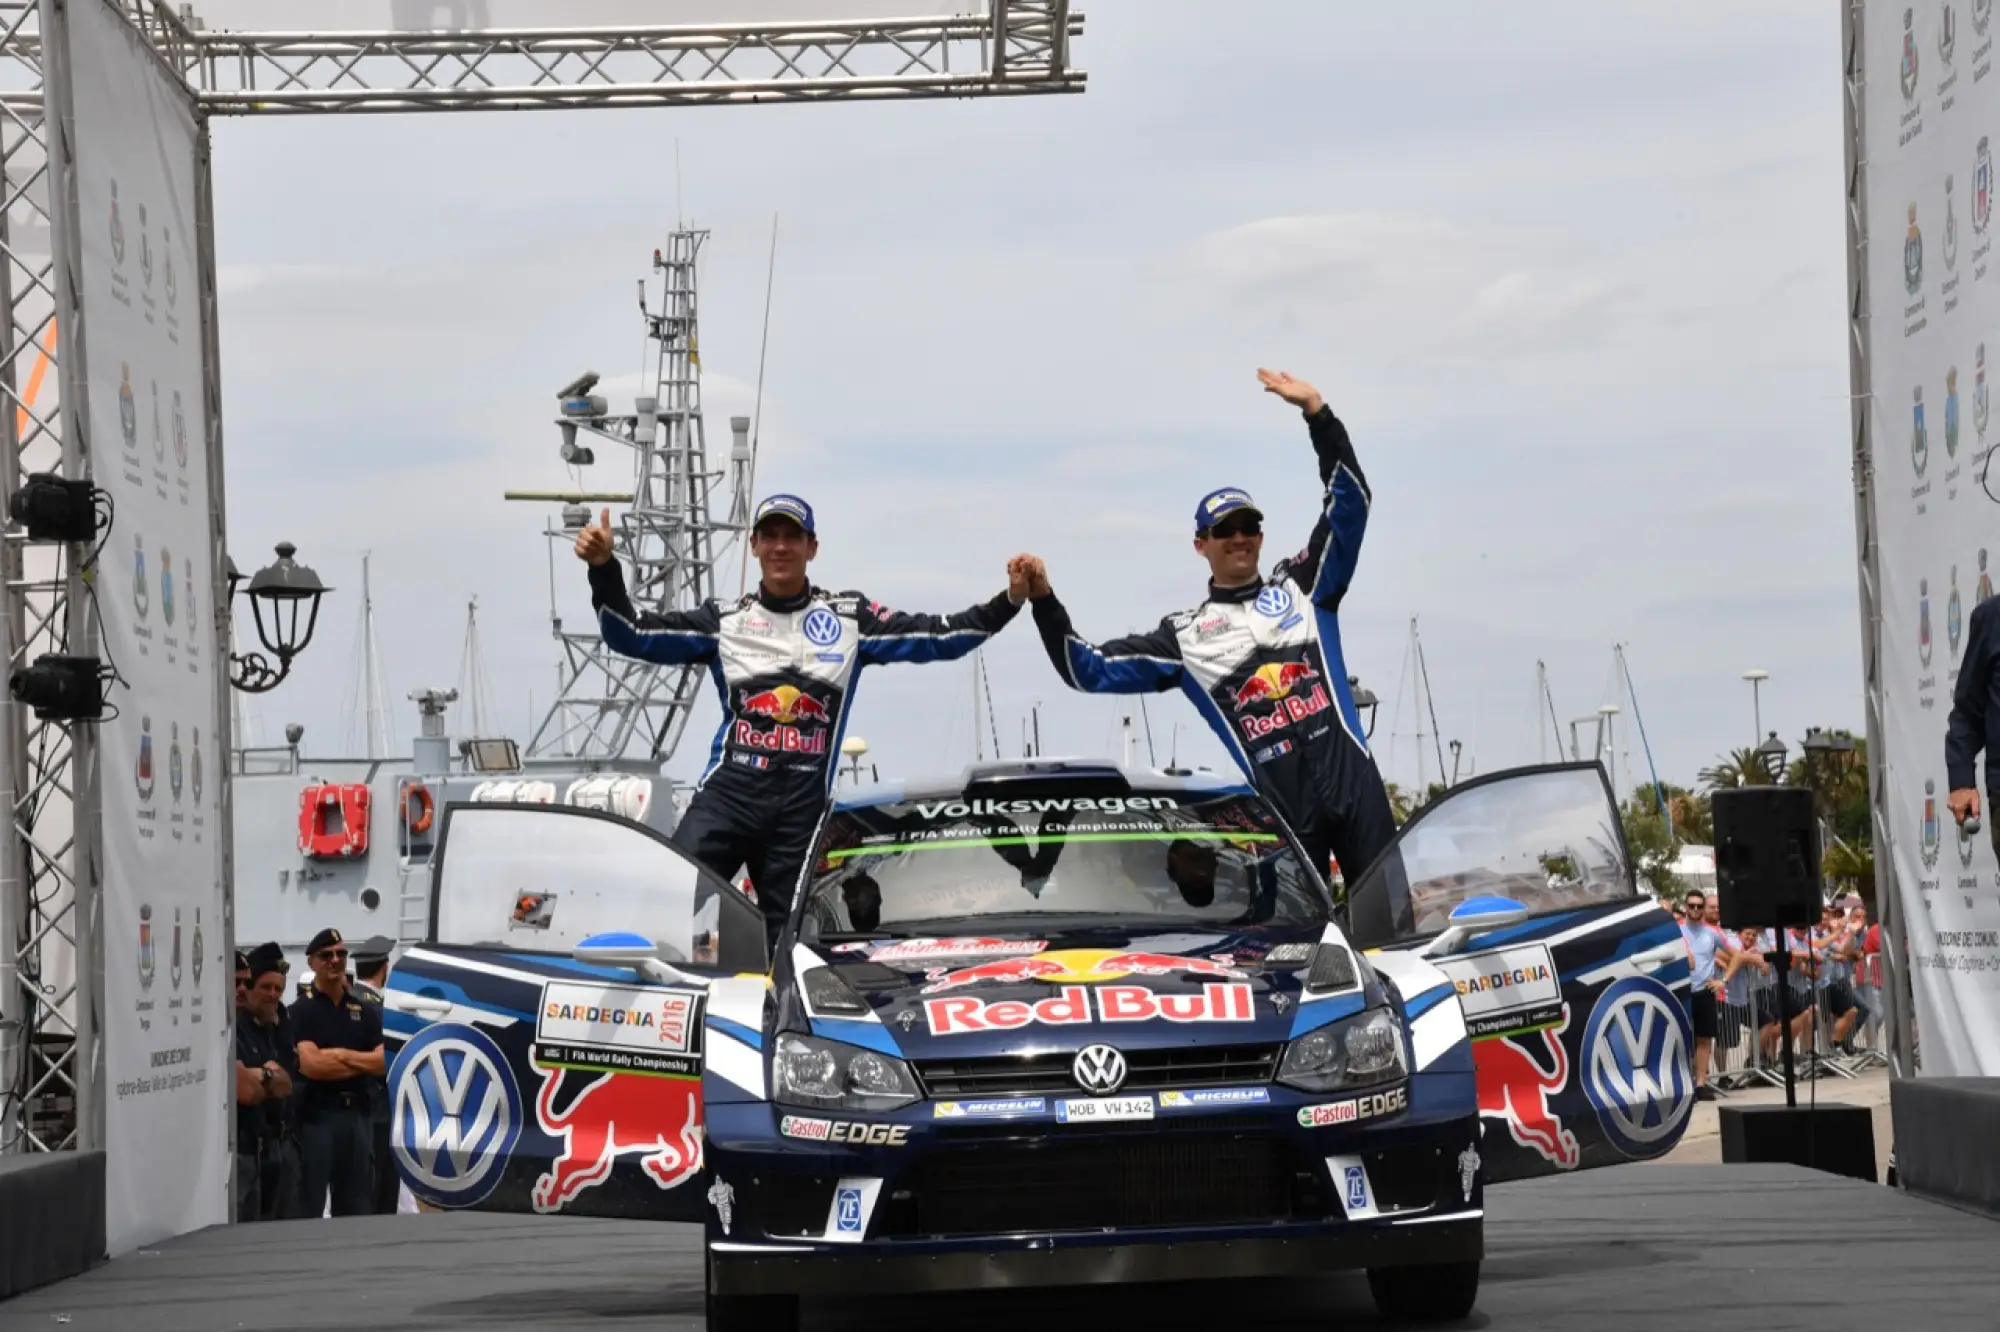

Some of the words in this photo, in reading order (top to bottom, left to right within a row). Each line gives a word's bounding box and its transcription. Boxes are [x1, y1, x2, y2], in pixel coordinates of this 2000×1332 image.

[1240, 700, 1290, 742] Red
[1284, 682, 1330, 722] Bull
[735, 719, 782, 750] Red
[782, 725, 827, 754] Bull
[916, 796, 1179, 819] Volkswagen
[910, 831, 938, 842] FIA
[943, 826, 992, 839] World
[998, 824, 1040, 836] Rally
[1044, 820, 1164, 834] Championship
[1455, 964, 1550, 996] SARDEGNA
[546, 1003, 655, 1028] SARDEGNA
[658, 999, 686, 1044] 2016
[923, 984, 1092, 1037] Red
[1095, 982, 1256, 1023] Bull
[572, 1051, 586, 1061] FIA
[587, 1051, 610, 1063] World
[612, 1053, 632, 1067] Rally
[633, 1055, 689, 1072] Championship
[967, 1101, 1042, 1113] MICHELIN
[1193, 1088, 1269, 1102] MICHELIN
[1313, 1102, 1355, 1124] Castrol
[1358, 1087, 1407, 1119] EDGE
[1068, 1105, 1096, 1116] WOB
[1105, 1103, 1121, 1115] VW
[1125, 1102, 1151, 1114] 142
[789, 1118, 829, 1138] Castrol
[828, 1120, 912, 1146] EDGE
